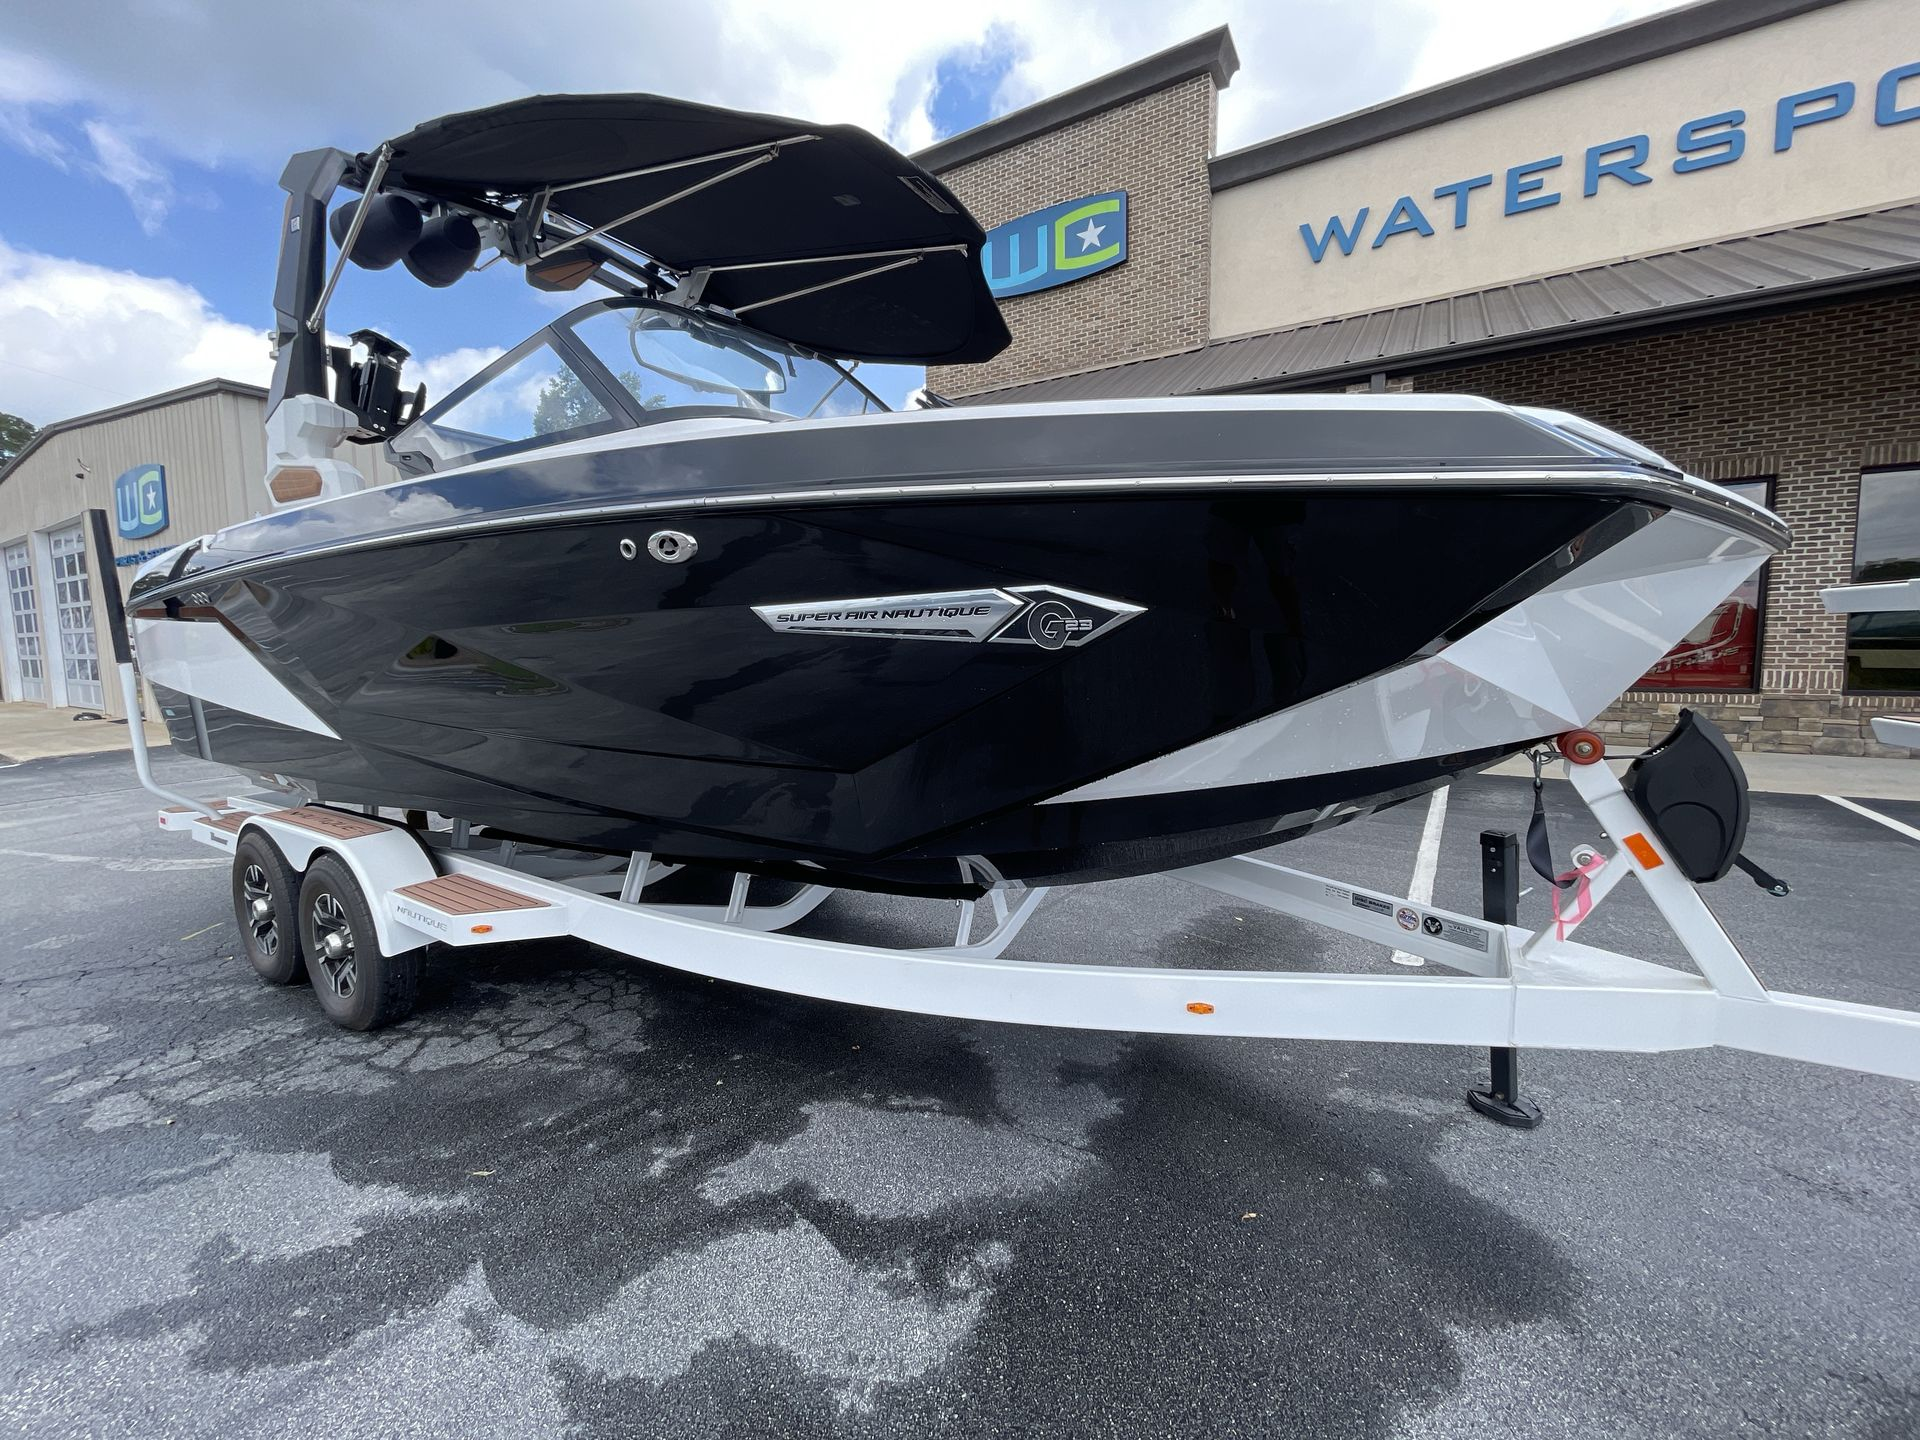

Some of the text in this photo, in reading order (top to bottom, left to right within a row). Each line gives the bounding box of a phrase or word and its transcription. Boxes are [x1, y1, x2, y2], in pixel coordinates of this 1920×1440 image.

[776, 605, 992, 623] SUPER AIR NAUTIQUE
[396, 905, 448, 933] NAUTIQUE
